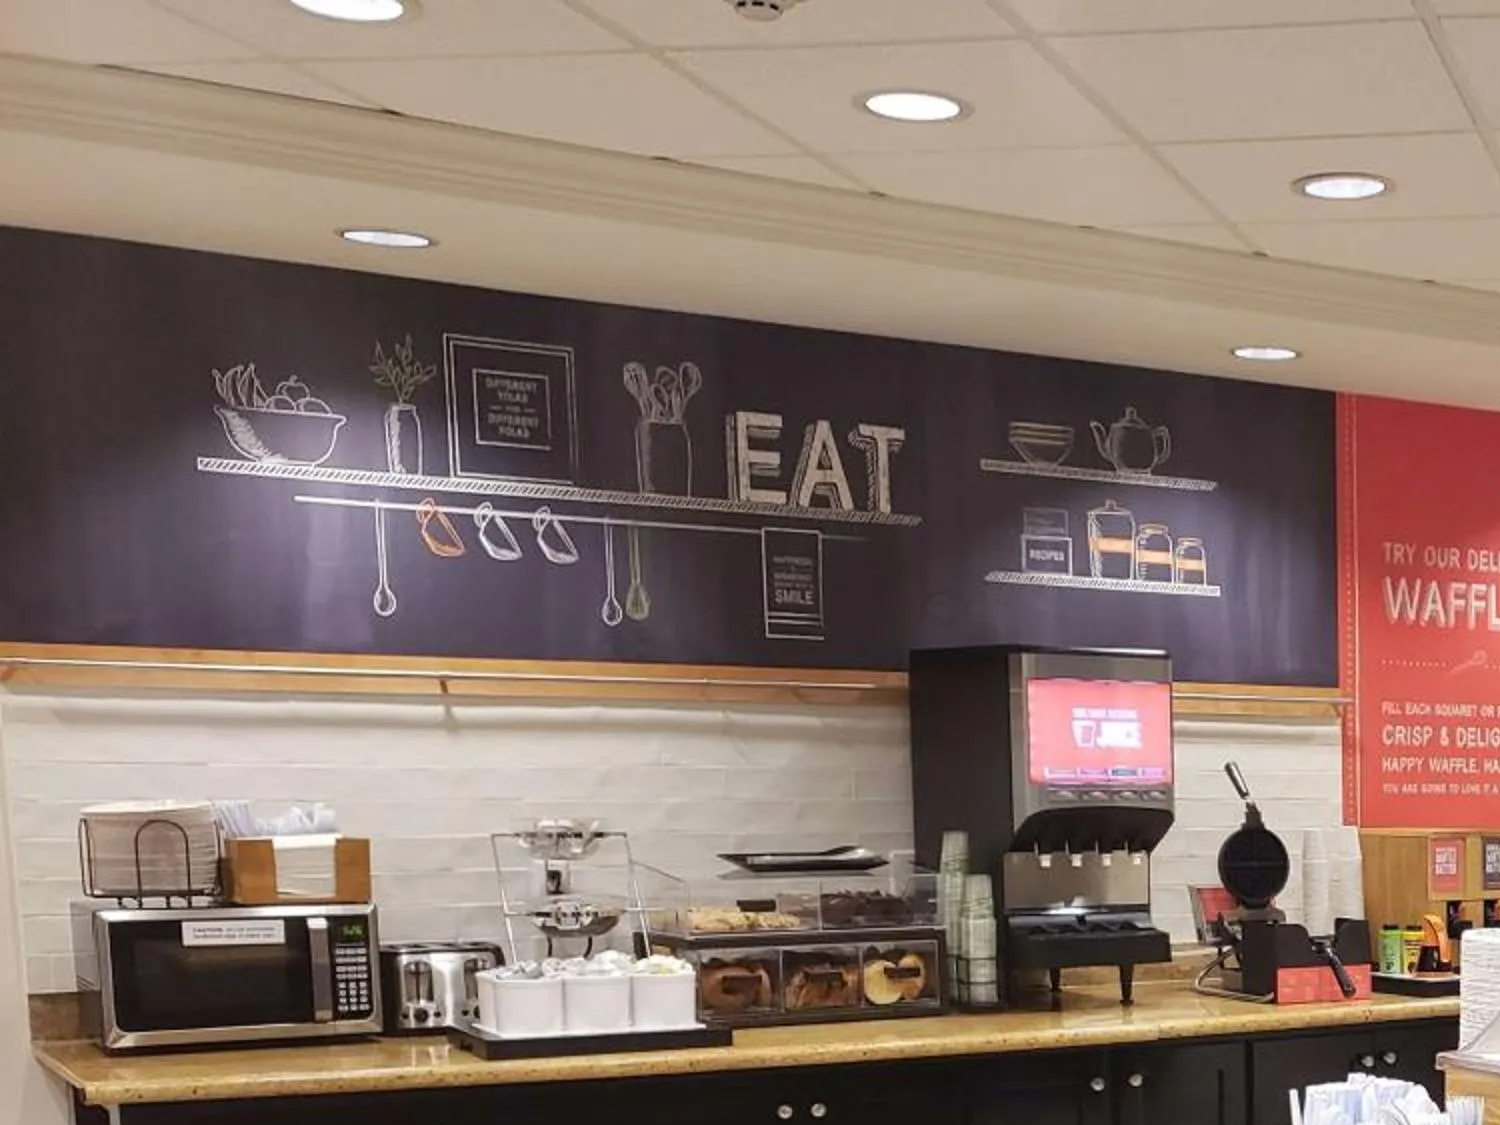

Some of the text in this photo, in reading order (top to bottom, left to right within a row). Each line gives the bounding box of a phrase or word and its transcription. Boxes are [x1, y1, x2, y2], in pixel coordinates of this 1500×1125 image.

[727, 410, 906, 516] EAT
[1382, 541, 1417, 565] TRY
[1424, 545, 1461, 570] OUR
[774, 589, 815, 606] SMILE
[1382, 701, 1402, 716] FILL
[1405, 702, 1432, 717] EACH
[1480, 704, 1495, 718] OR
[1382, 725, 1433, 747] CRISP
[1440, 726, 1450, 747] &
[1382, 756, 1425, 773] HAPPY
